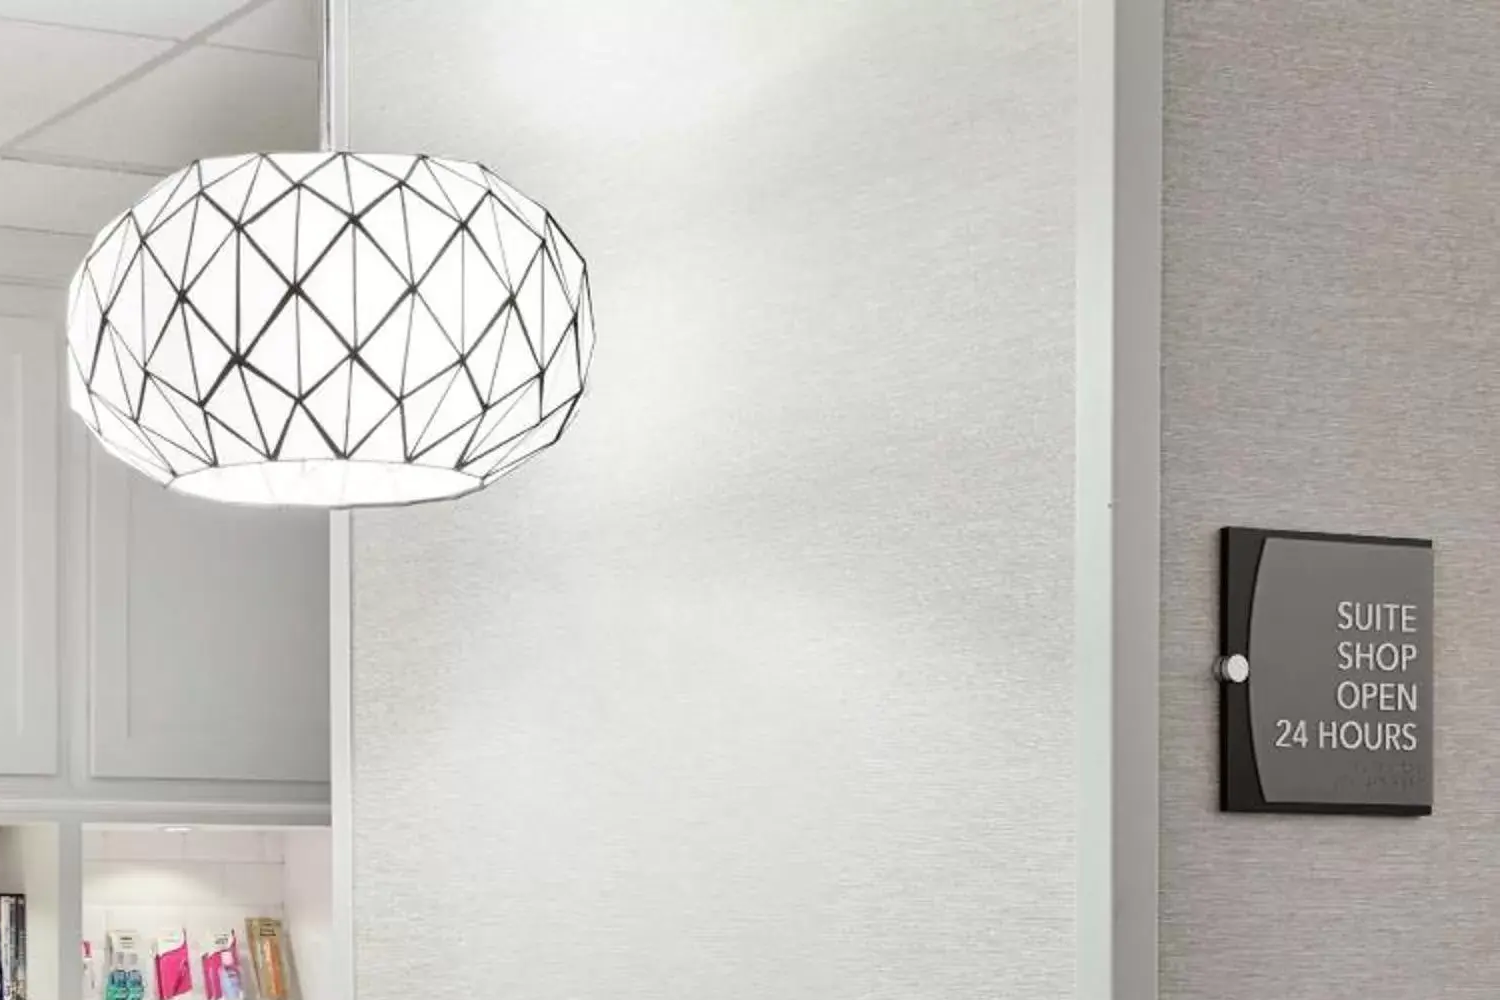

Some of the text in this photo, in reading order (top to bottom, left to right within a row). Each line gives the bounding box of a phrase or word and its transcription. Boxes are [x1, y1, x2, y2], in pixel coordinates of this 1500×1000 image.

[1337, 601, 1417, 632] SUITE
[1337, 641, 1417, 671] SHOP
[1337, 681, 1417, 711] OPEN
[1275, 719, 1417, 751] 24 HOURS
